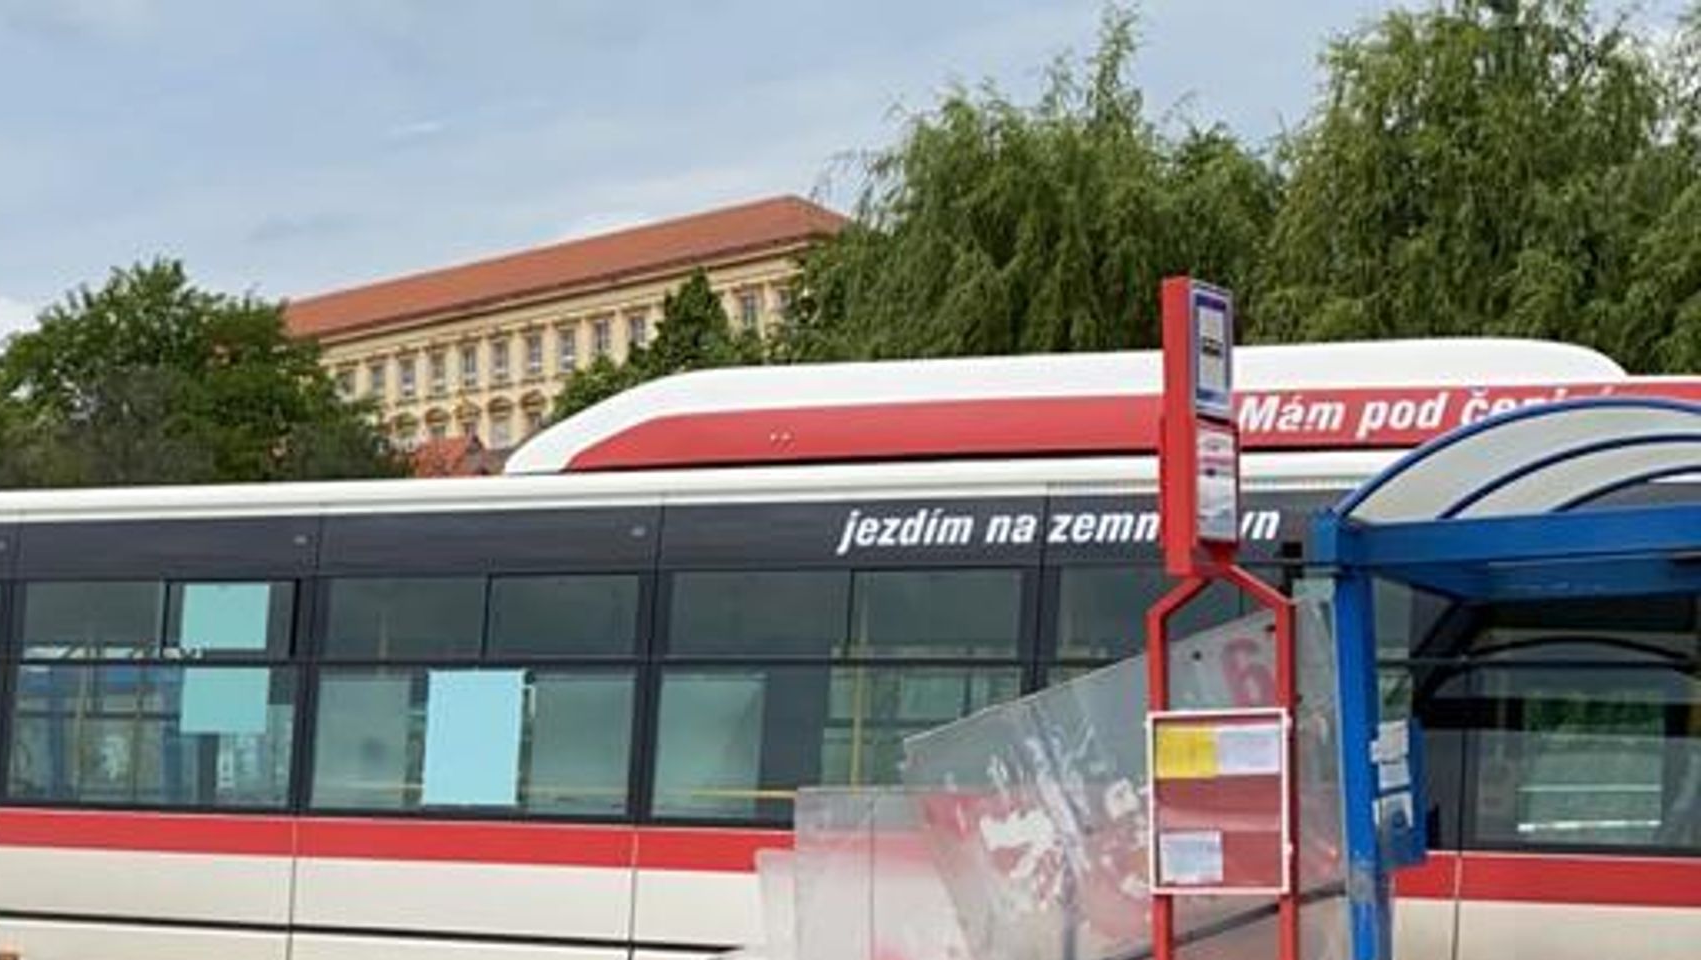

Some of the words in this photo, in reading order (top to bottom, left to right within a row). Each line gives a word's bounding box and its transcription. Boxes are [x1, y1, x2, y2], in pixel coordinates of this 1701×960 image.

[1239, 393, 1346, 432] Mám
[1355, 391, 1449, 440] pod
[836, 507, 974, 555] jezdím
[985, 513, 1038, 544] na
